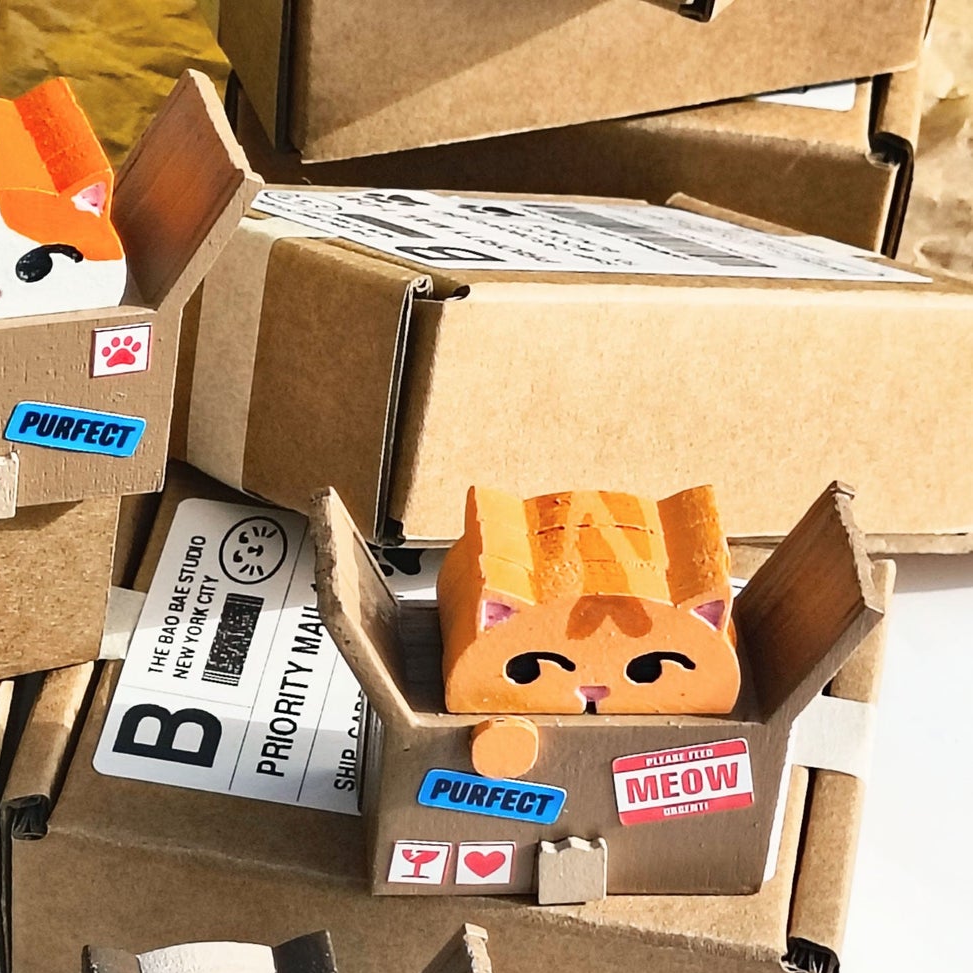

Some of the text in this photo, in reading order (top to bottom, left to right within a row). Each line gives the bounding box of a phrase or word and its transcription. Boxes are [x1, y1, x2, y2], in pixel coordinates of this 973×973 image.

[18, 410, 137, 449] PURFECT
[147, 535, 207, 673] THE BAO BAE STUDIO
[172, 574, 220, 680] NEW YORK CITY
[112, 702, 223, 769] B
[256, 660, 313, 777] PRIORITY
[625, 762, 739, 804] MEOW
[645, 749, 714, 767] PLEASE FEED
[429, 778, 556, 818] PURFECT
